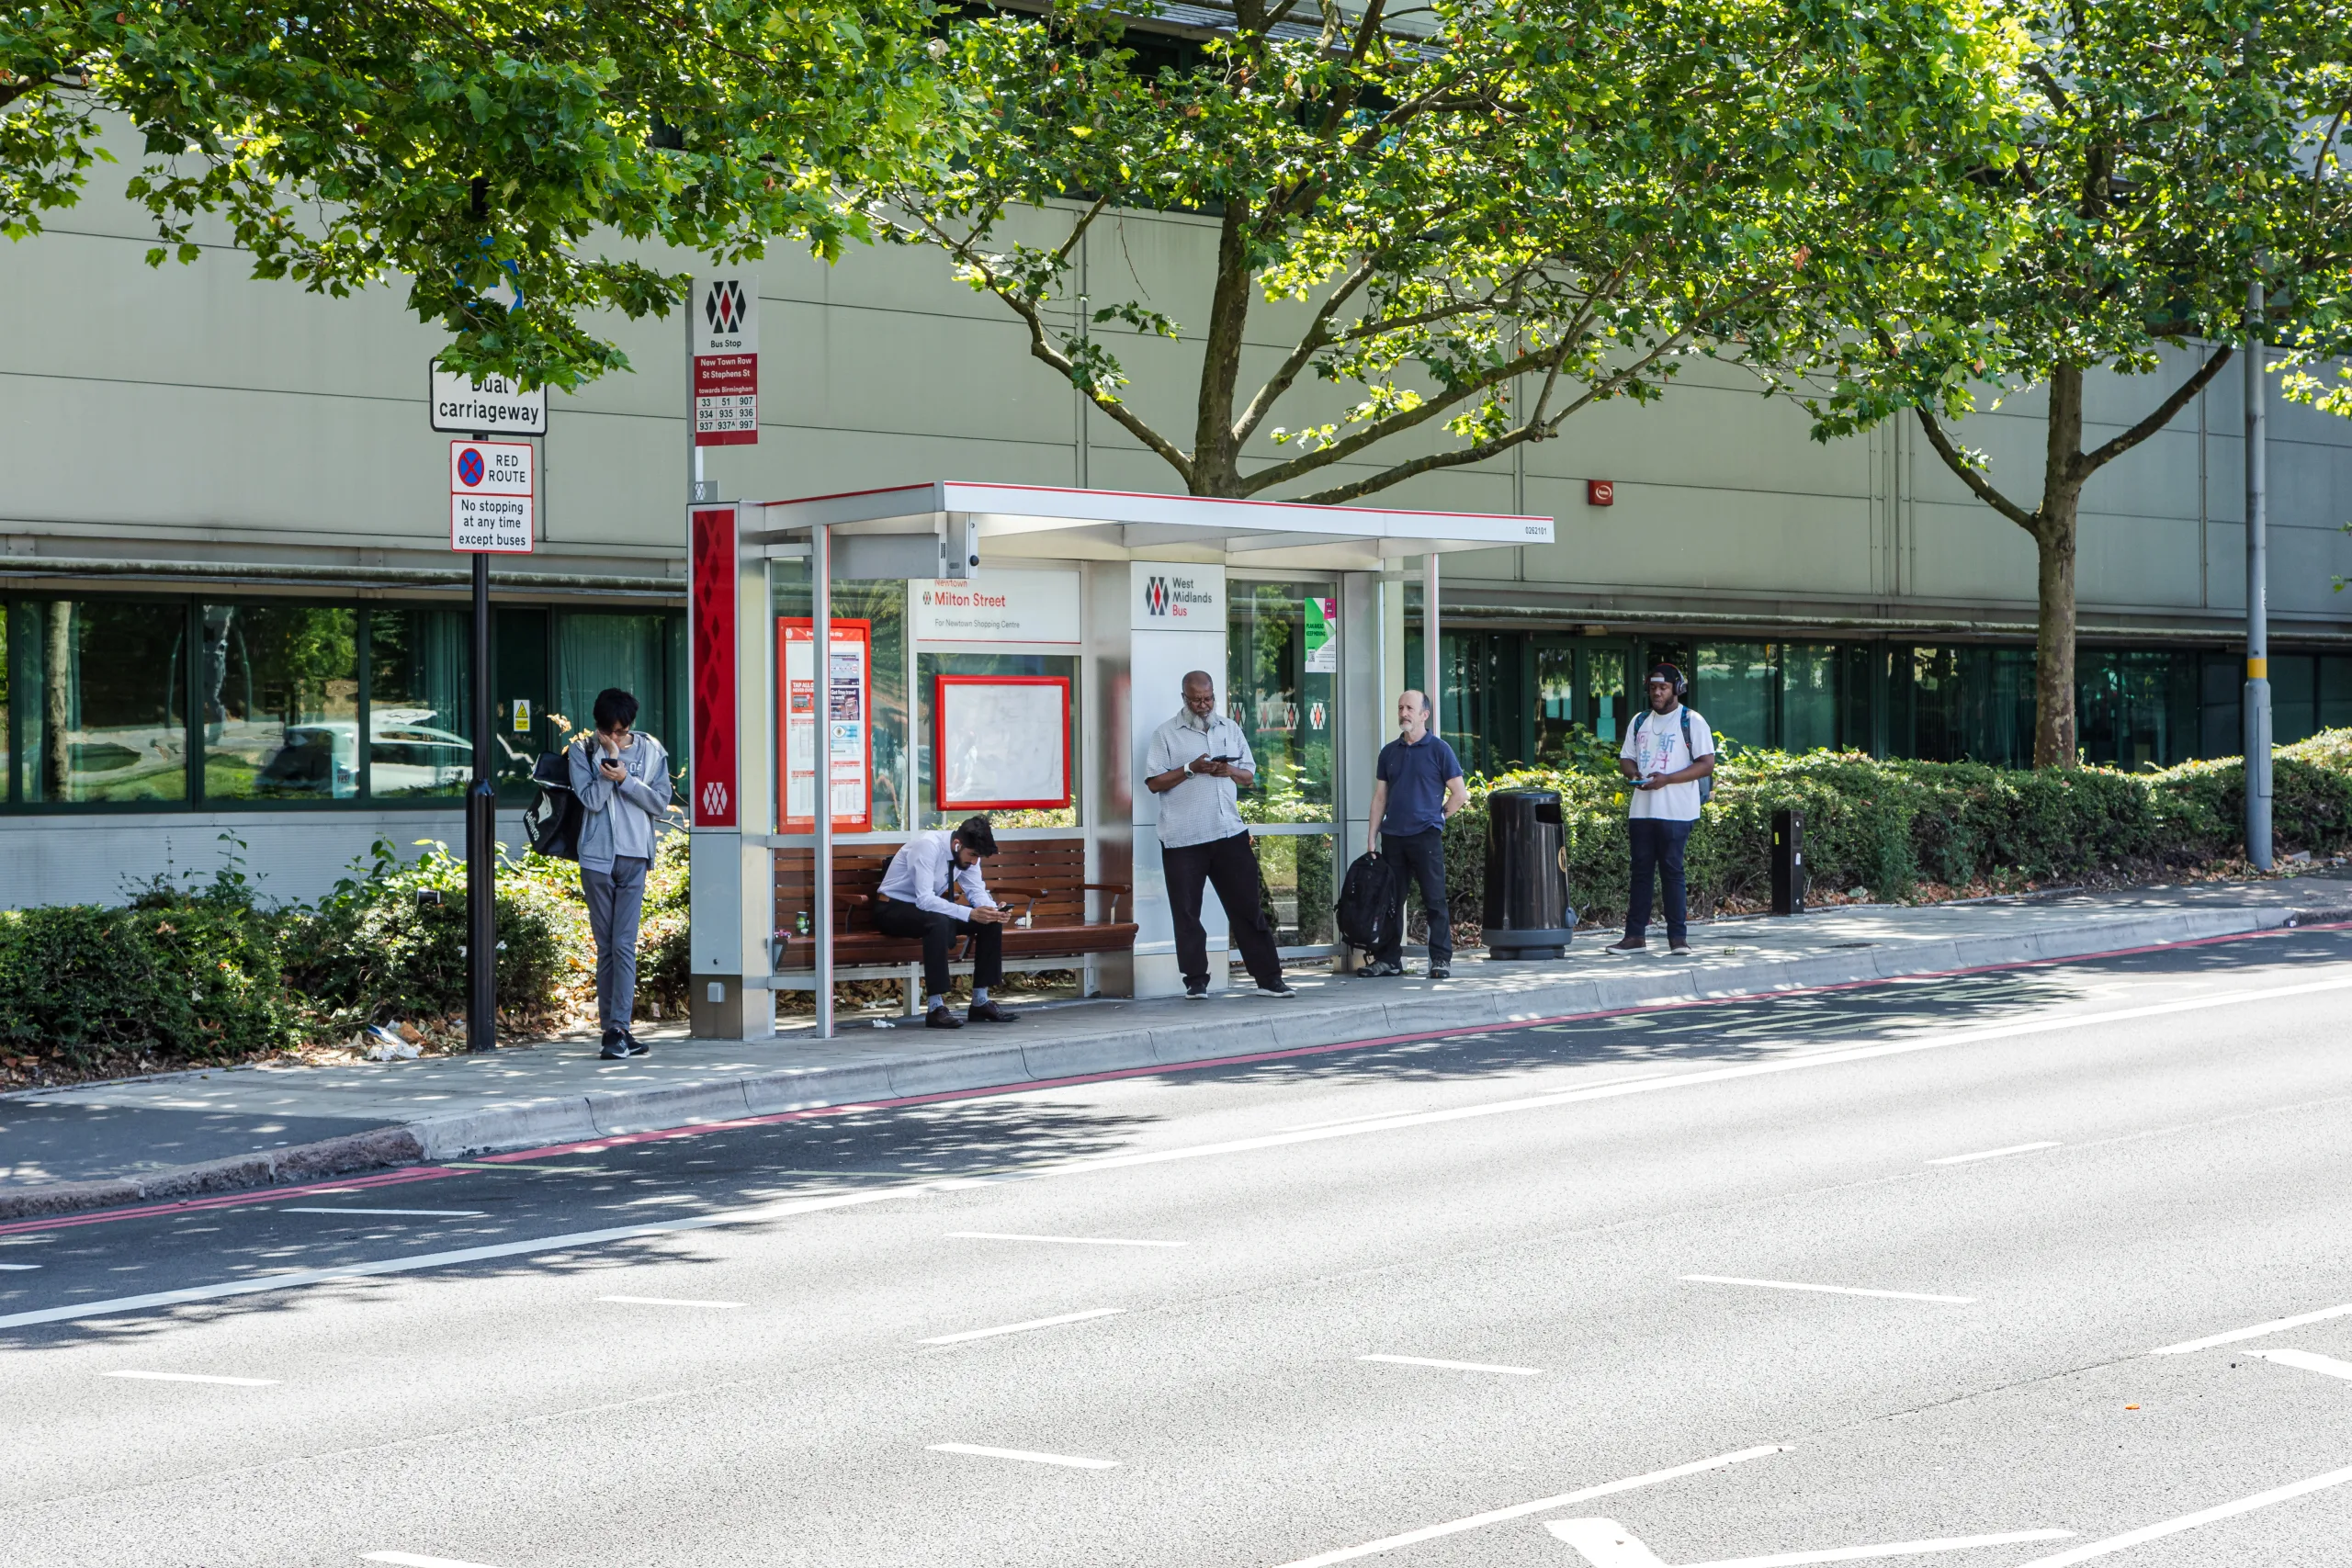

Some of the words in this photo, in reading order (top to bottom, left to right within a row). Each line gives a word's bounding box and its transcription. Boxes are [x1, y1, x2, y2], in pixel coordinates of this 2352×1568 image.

[710, 340, 723, 348] Bus
[724, 339, 742, 348] Stop
[700, 358, 716, 367] New
[717, 357, 736, 366] Town
[737, 356, 752, 365] Row
[702, 371, 710, 379] St
[710, 369, 741, 379] Stephens
[721, 385, 753, 393] Birmingham
[701, 398, 711, 407] 33
[721, 397, 730, 406] 51
[739, 396, 753, 405] 907
[439, 399, 539, 425] carriageway
[699, 410, 713, 419] 934
[718, 409, 733, 418] 935
[739, 408, 753, 417] 936
[699, 422, 713, 431] 937
[739, 420, 753, 429] 997
[496, 454, 518, 467] RED
[489, 469, 526, 483] ROUTE
[461, 499, 476, 512] No
[479, 500, 524, 515] stopping
[463, 515, 474, 527] at
[477, 517, 495, 530] any
[499, 516, 521, 529] time
[1525, 526, 1547, 535] 0262101
[458, 534, 493, 547] except
[496, 534, 526, 547] buses
[934, 578, 967, 588] Newtown
[1172, 577, 1194, 589] West
[934, 592, 970, 606] Milton
[973, 592, 1006, 607] Street
[1172, 592, 1213, 604] Midlands
[1172, 604, 1187, 616] Bus
[934, 618, 944, 626] For
[945, 619, 973, 627] Newtown
[974, 619, 1001, 629] Shopping
